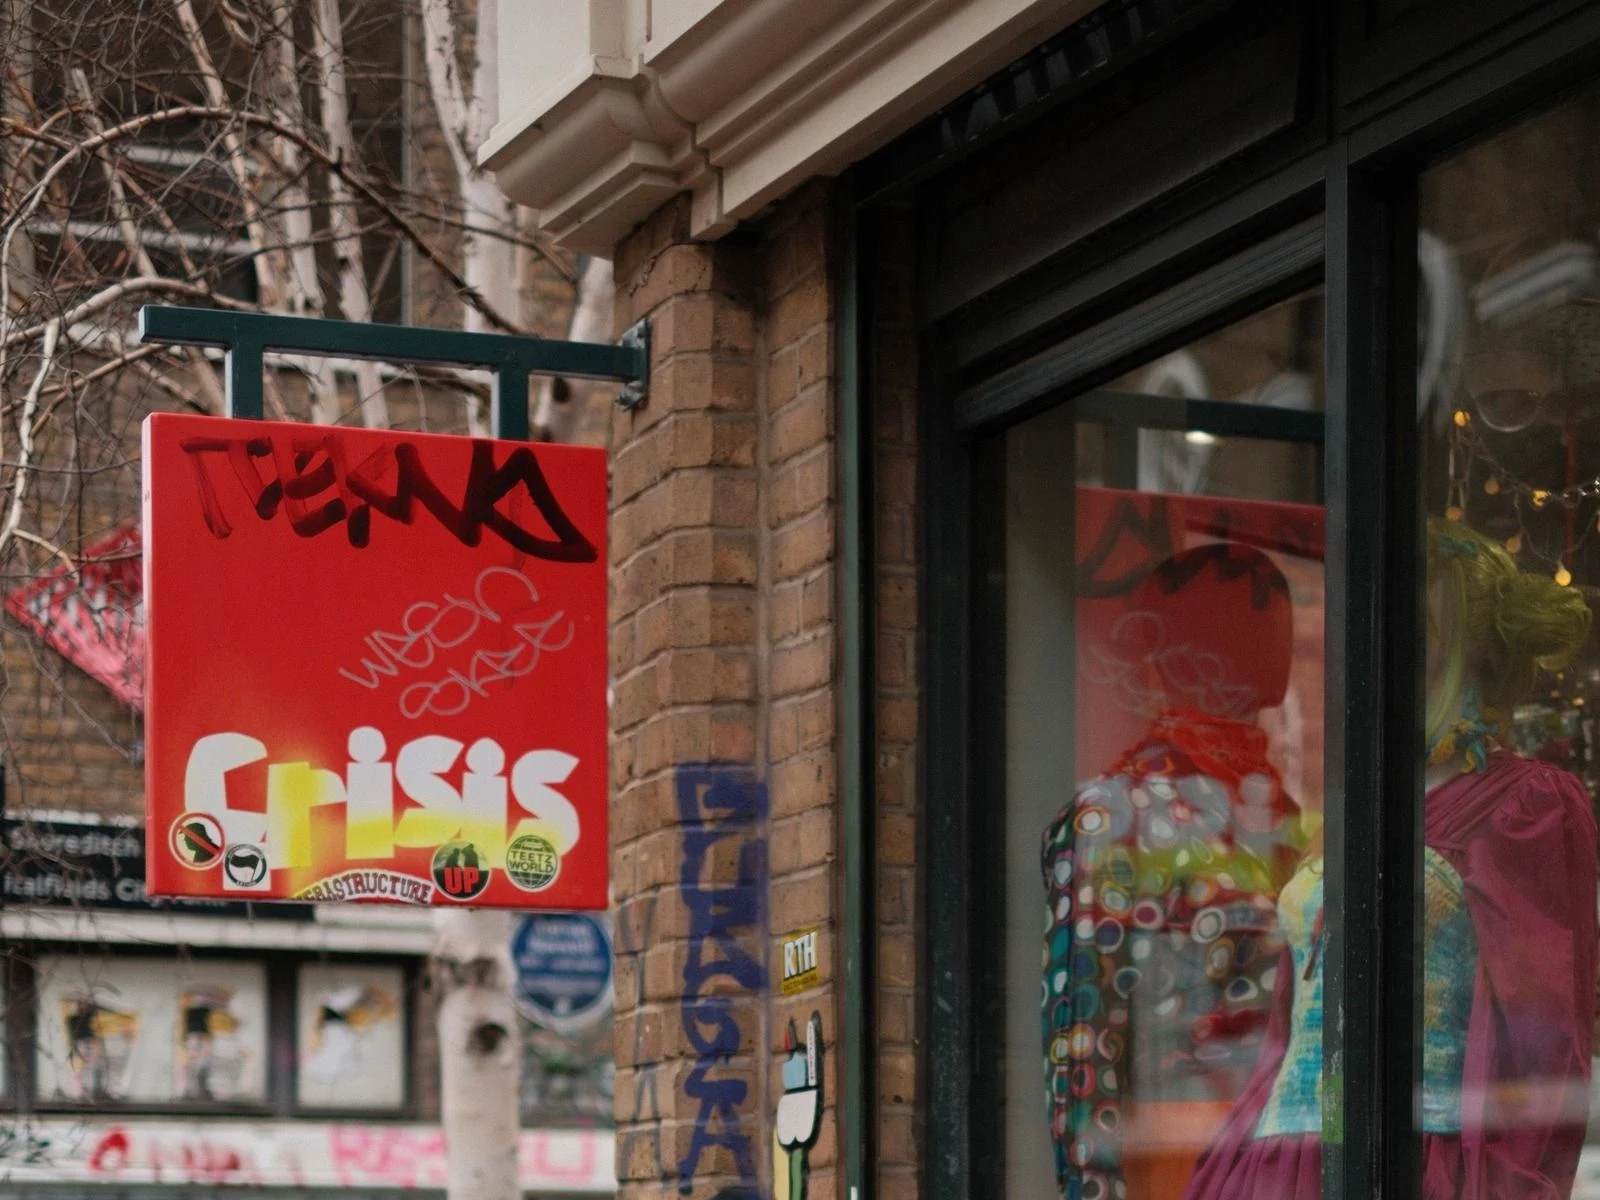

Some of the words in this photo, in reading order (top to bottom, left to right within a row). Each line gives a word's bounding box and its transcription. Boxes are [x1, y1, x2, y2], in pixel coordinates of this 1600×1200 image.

[185, 726, 580, 870] Crisis
[509, 860, 554, 873] WORLD
[511, 850, 553, 864] TEETZ
[444, 866, 479, 894] UP
[784, 931, 818, 979] RTH
